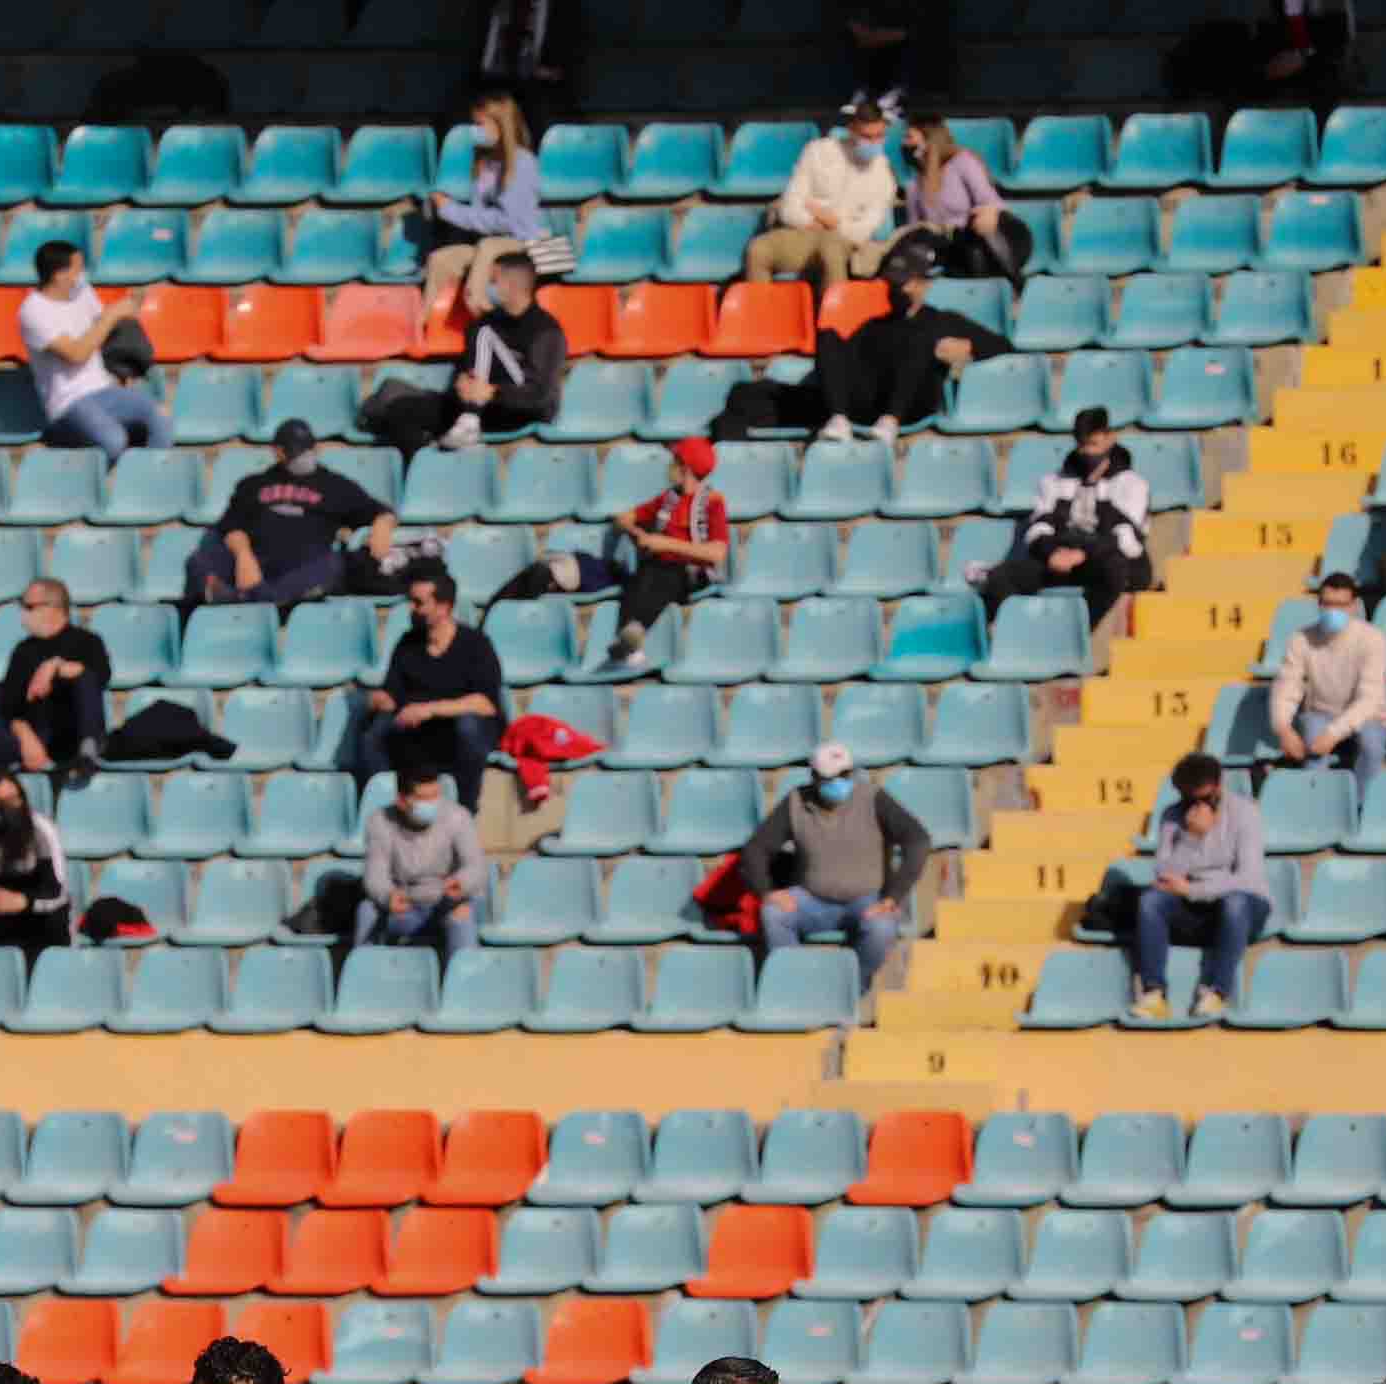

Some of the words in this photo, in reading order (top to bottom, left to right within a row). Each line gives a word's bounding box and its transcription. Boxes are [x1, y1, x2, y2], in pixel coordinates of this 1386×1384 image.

[1323, 442, 1357, 466] 16
[1209, 606, 1243, 629] 14
[1099, 779, 1133, 804] 12
[1037, 865, 1065, 889] 11
[982, 964, 1020, 988] 10
